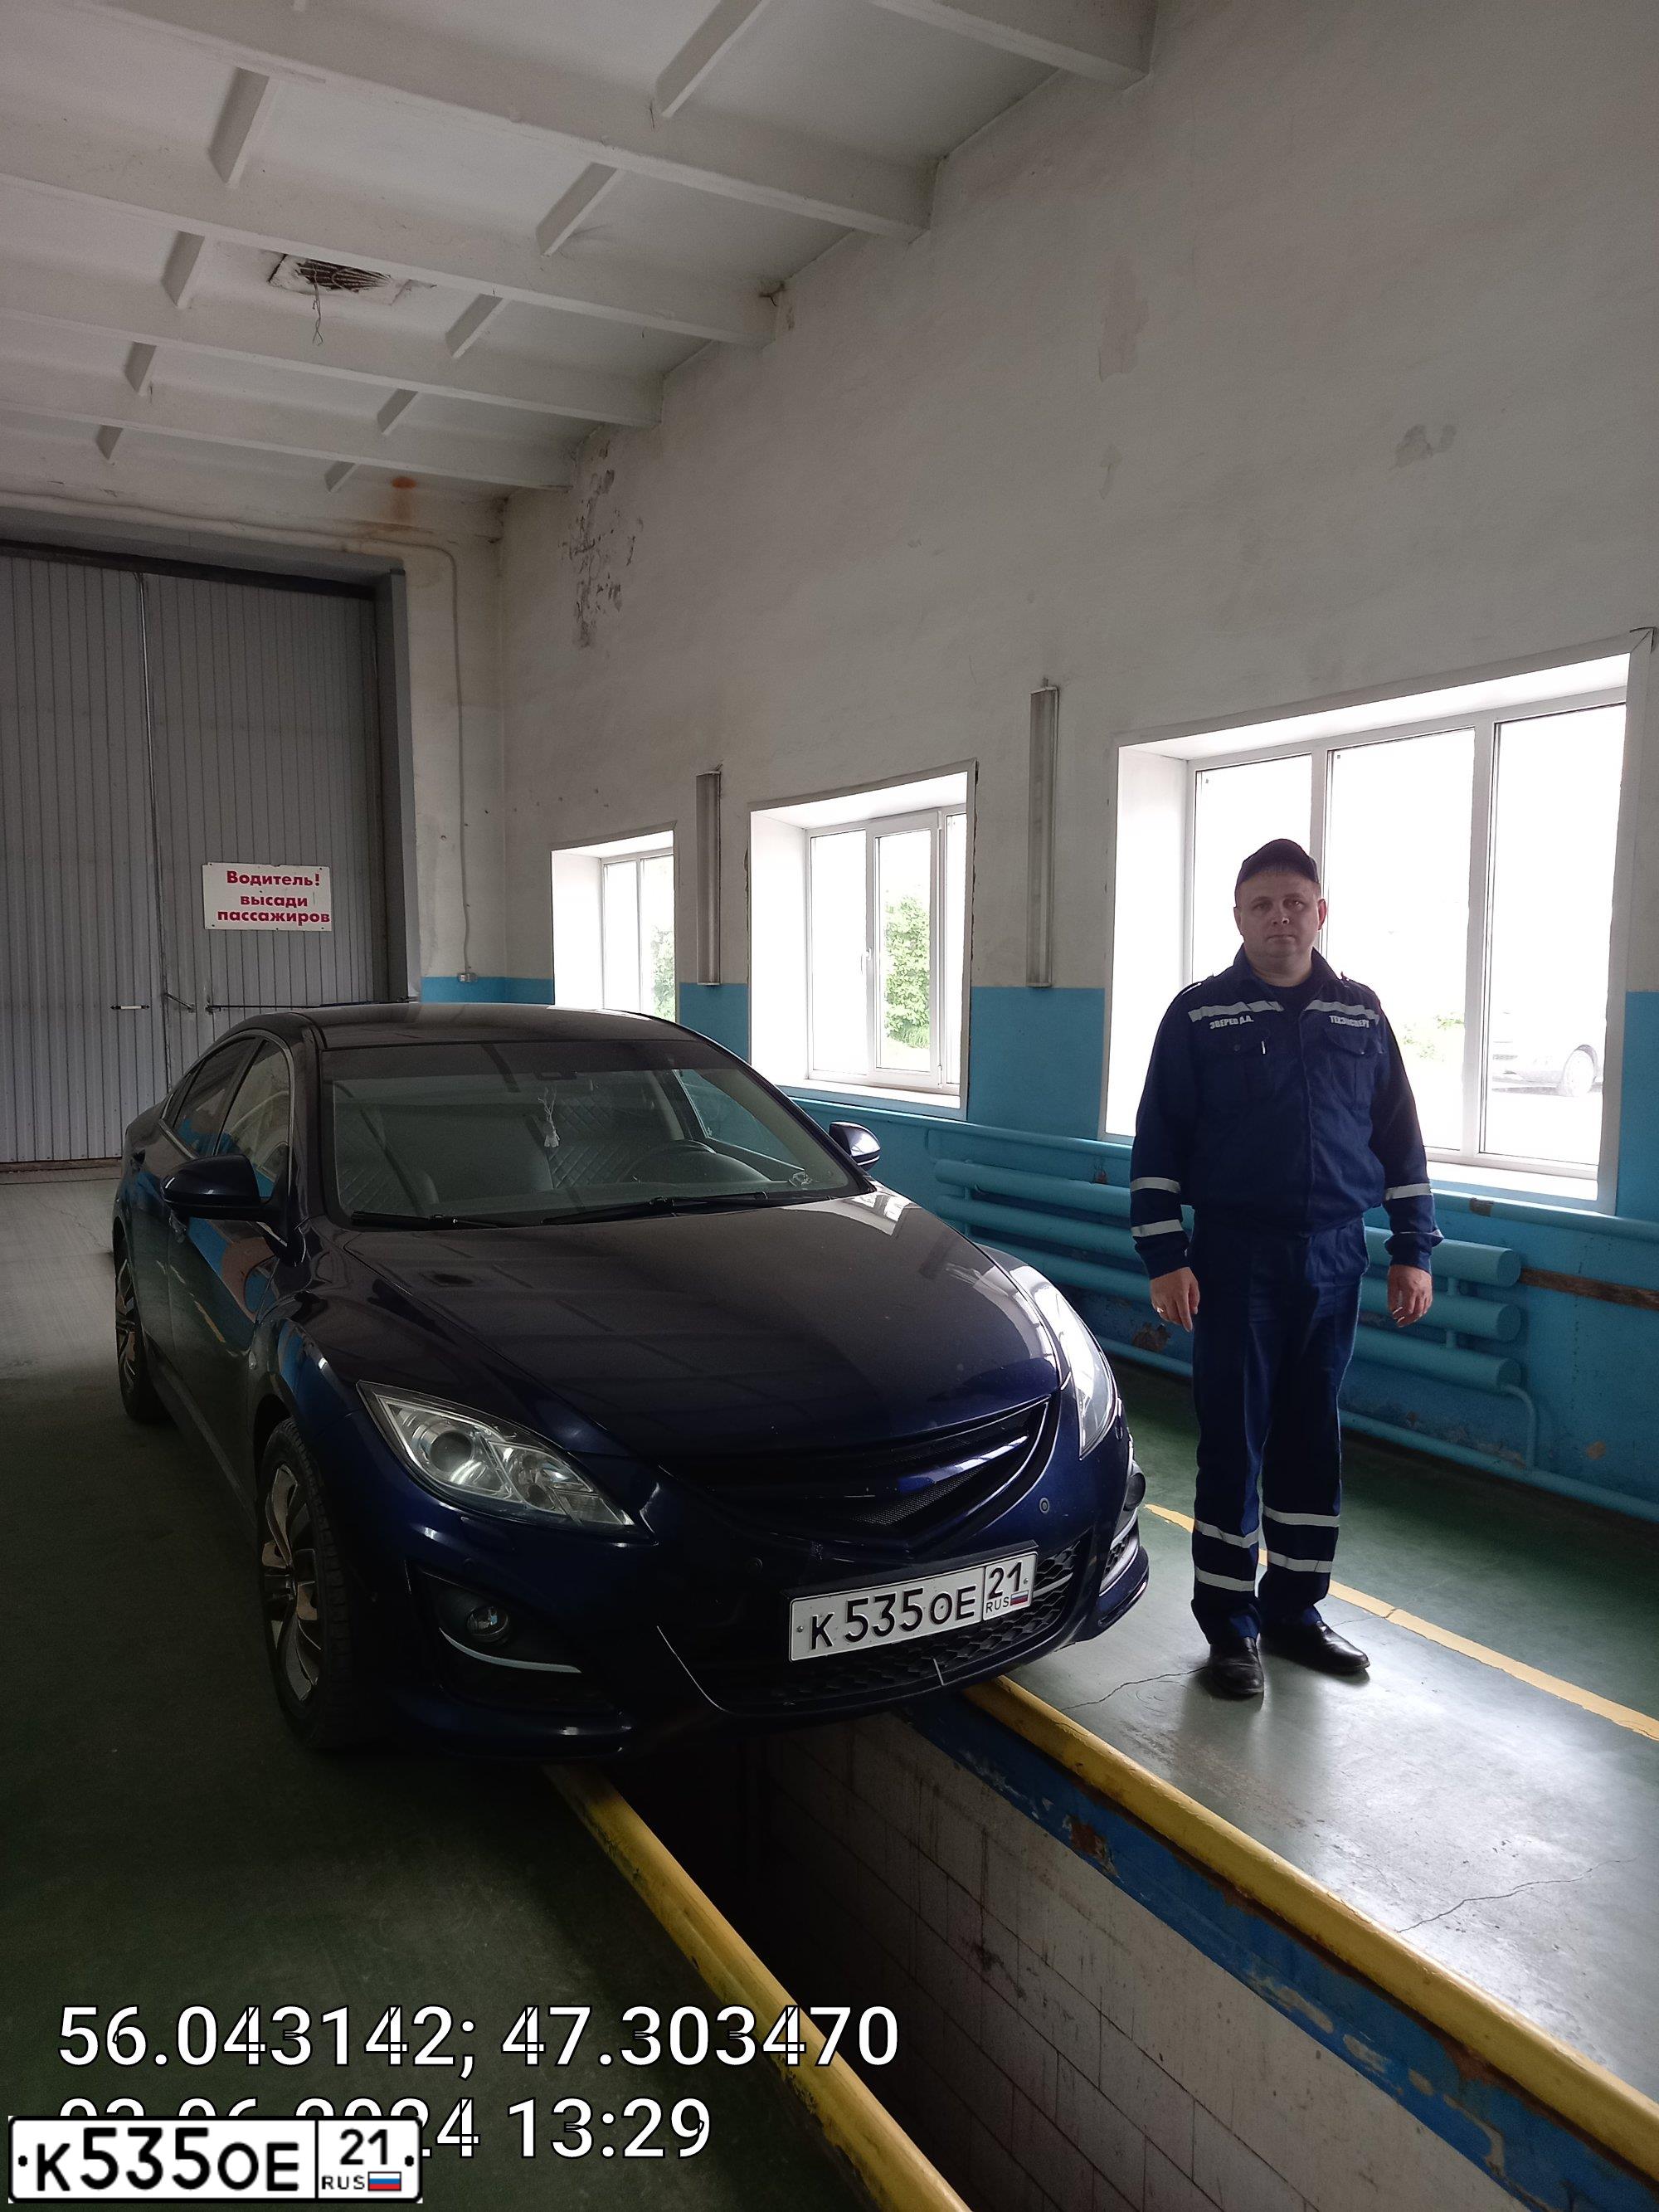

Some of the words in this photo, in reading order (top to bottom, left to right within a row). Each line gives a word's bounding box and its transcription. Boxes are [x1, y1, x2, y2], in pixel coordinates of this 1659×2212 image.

[226, 870, 320, 886] Водитель!
[240, 895, 308, 909] высади
[217, 911, 330, 926] пассажиров
[988, 1562, 1024, 1600] 21
[985, 1596, 1010, 1615] RUS
